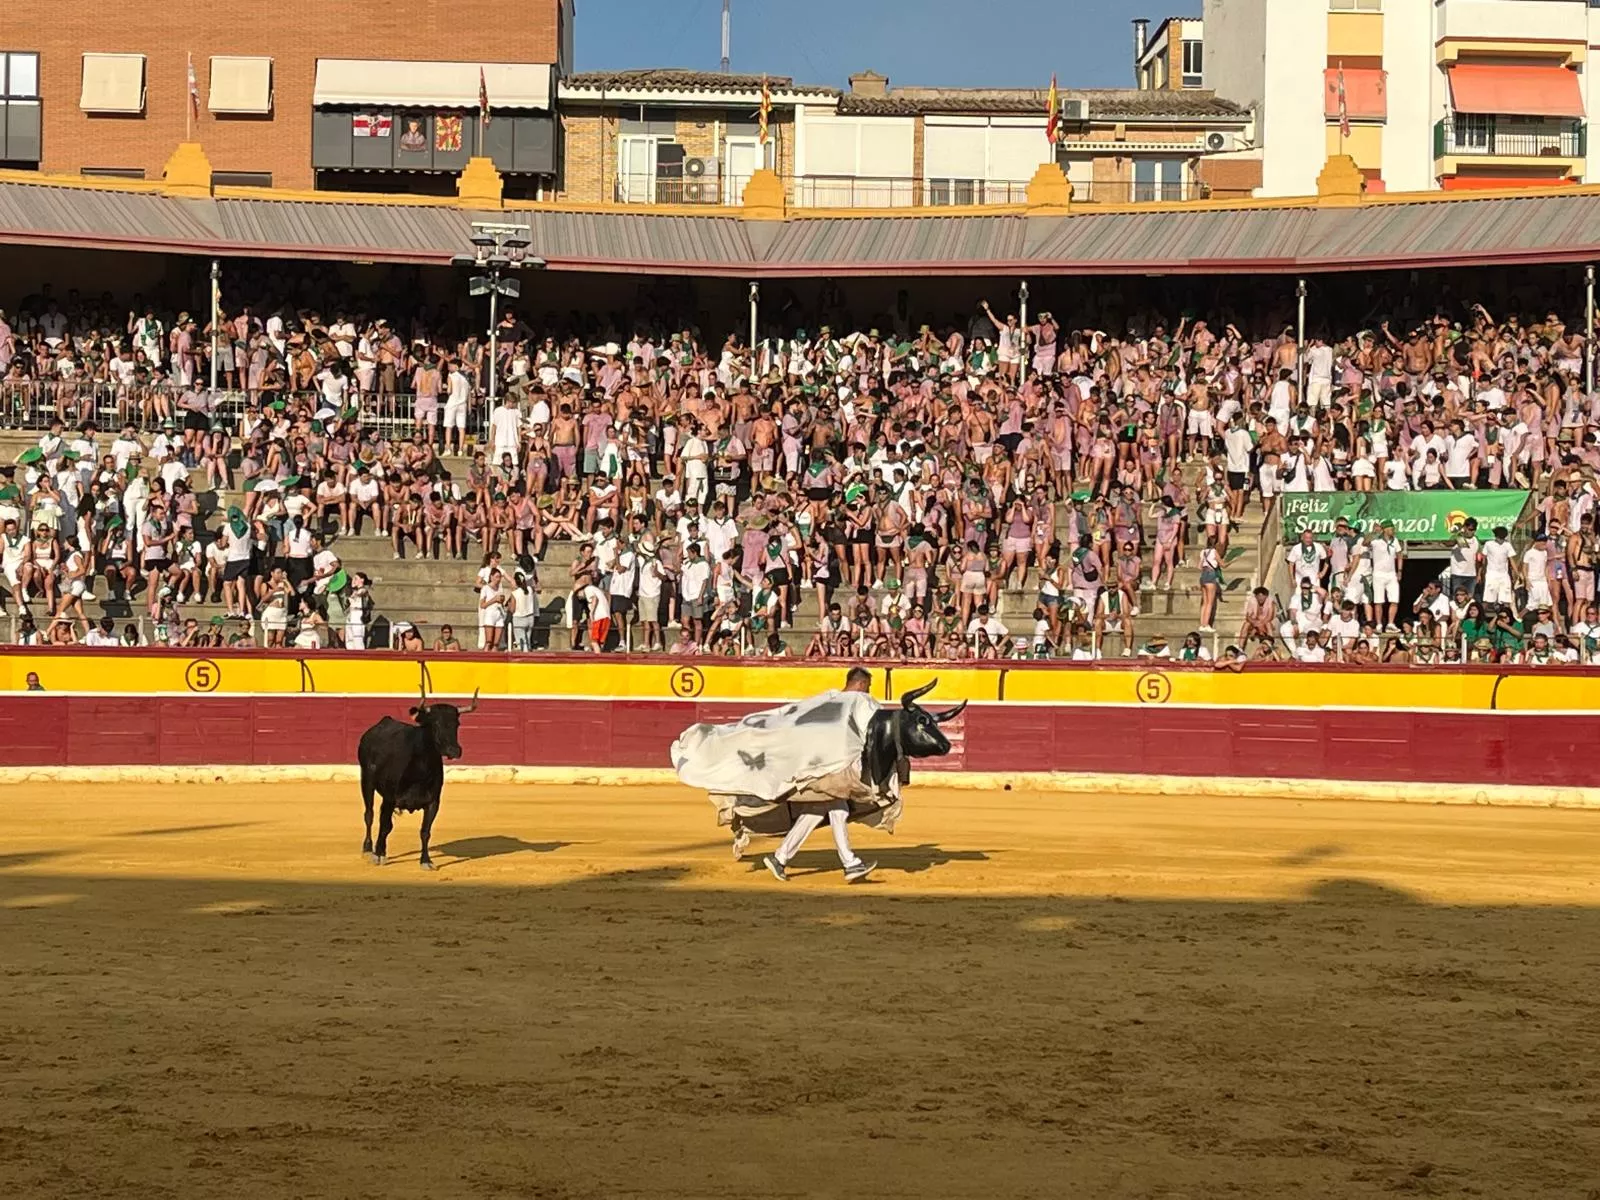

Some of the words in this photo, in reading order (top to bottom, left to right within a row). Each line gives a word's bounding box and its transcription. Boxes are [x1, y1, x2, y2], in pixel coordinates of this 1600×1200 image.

[1286, 499, 1328, 516] ¡Feliz
[1295, 515, 1336, 533] San
[1344, 514, 1437, 533] ornzo!
[196, 666, 210, 687] 5
[681, 672, 694, 692] 5
[1147, 679, 1160, 699] 5
